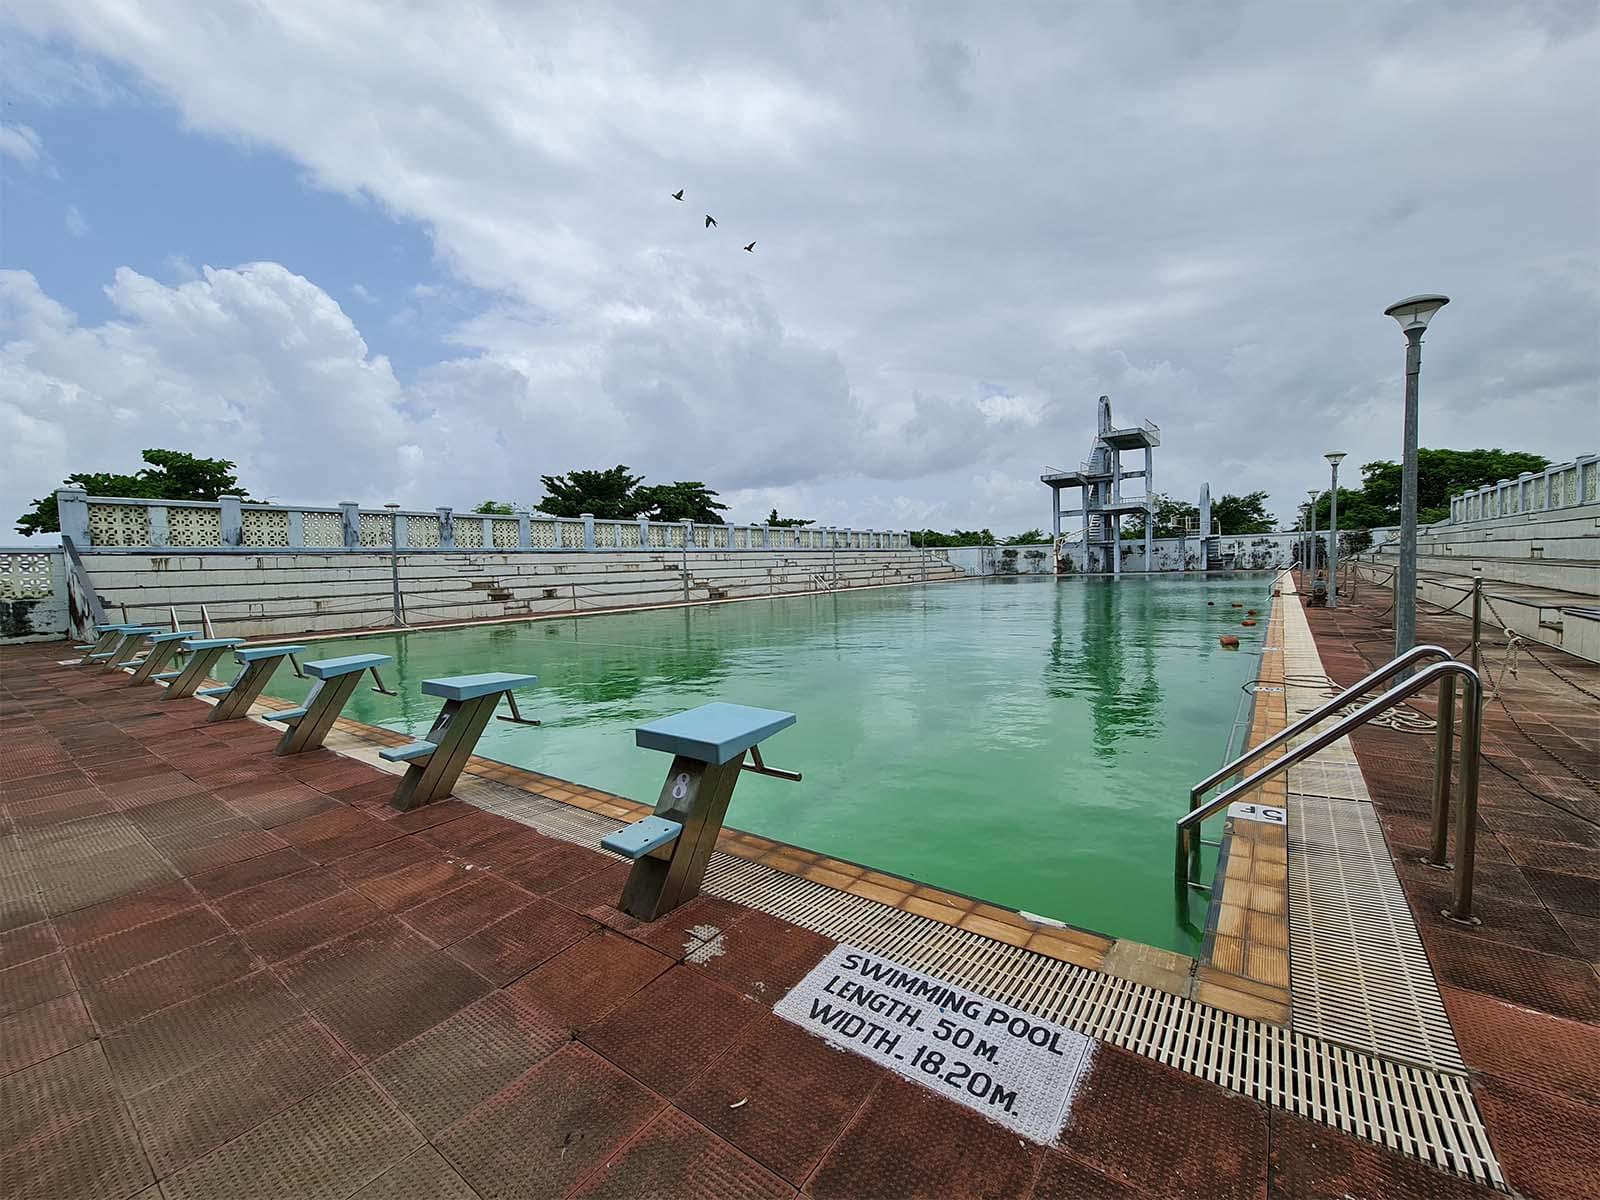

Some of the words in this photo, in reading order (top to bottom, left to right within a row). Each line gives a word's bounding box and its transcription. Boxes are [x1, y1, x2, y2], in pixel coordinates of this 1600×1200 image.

[437, 713, 450, 731] 7
[672, 772, 689, 799] 8
[841, 954, 983, 1020] SWIMMING
[985, 1008, 1064, 1056] POOL
